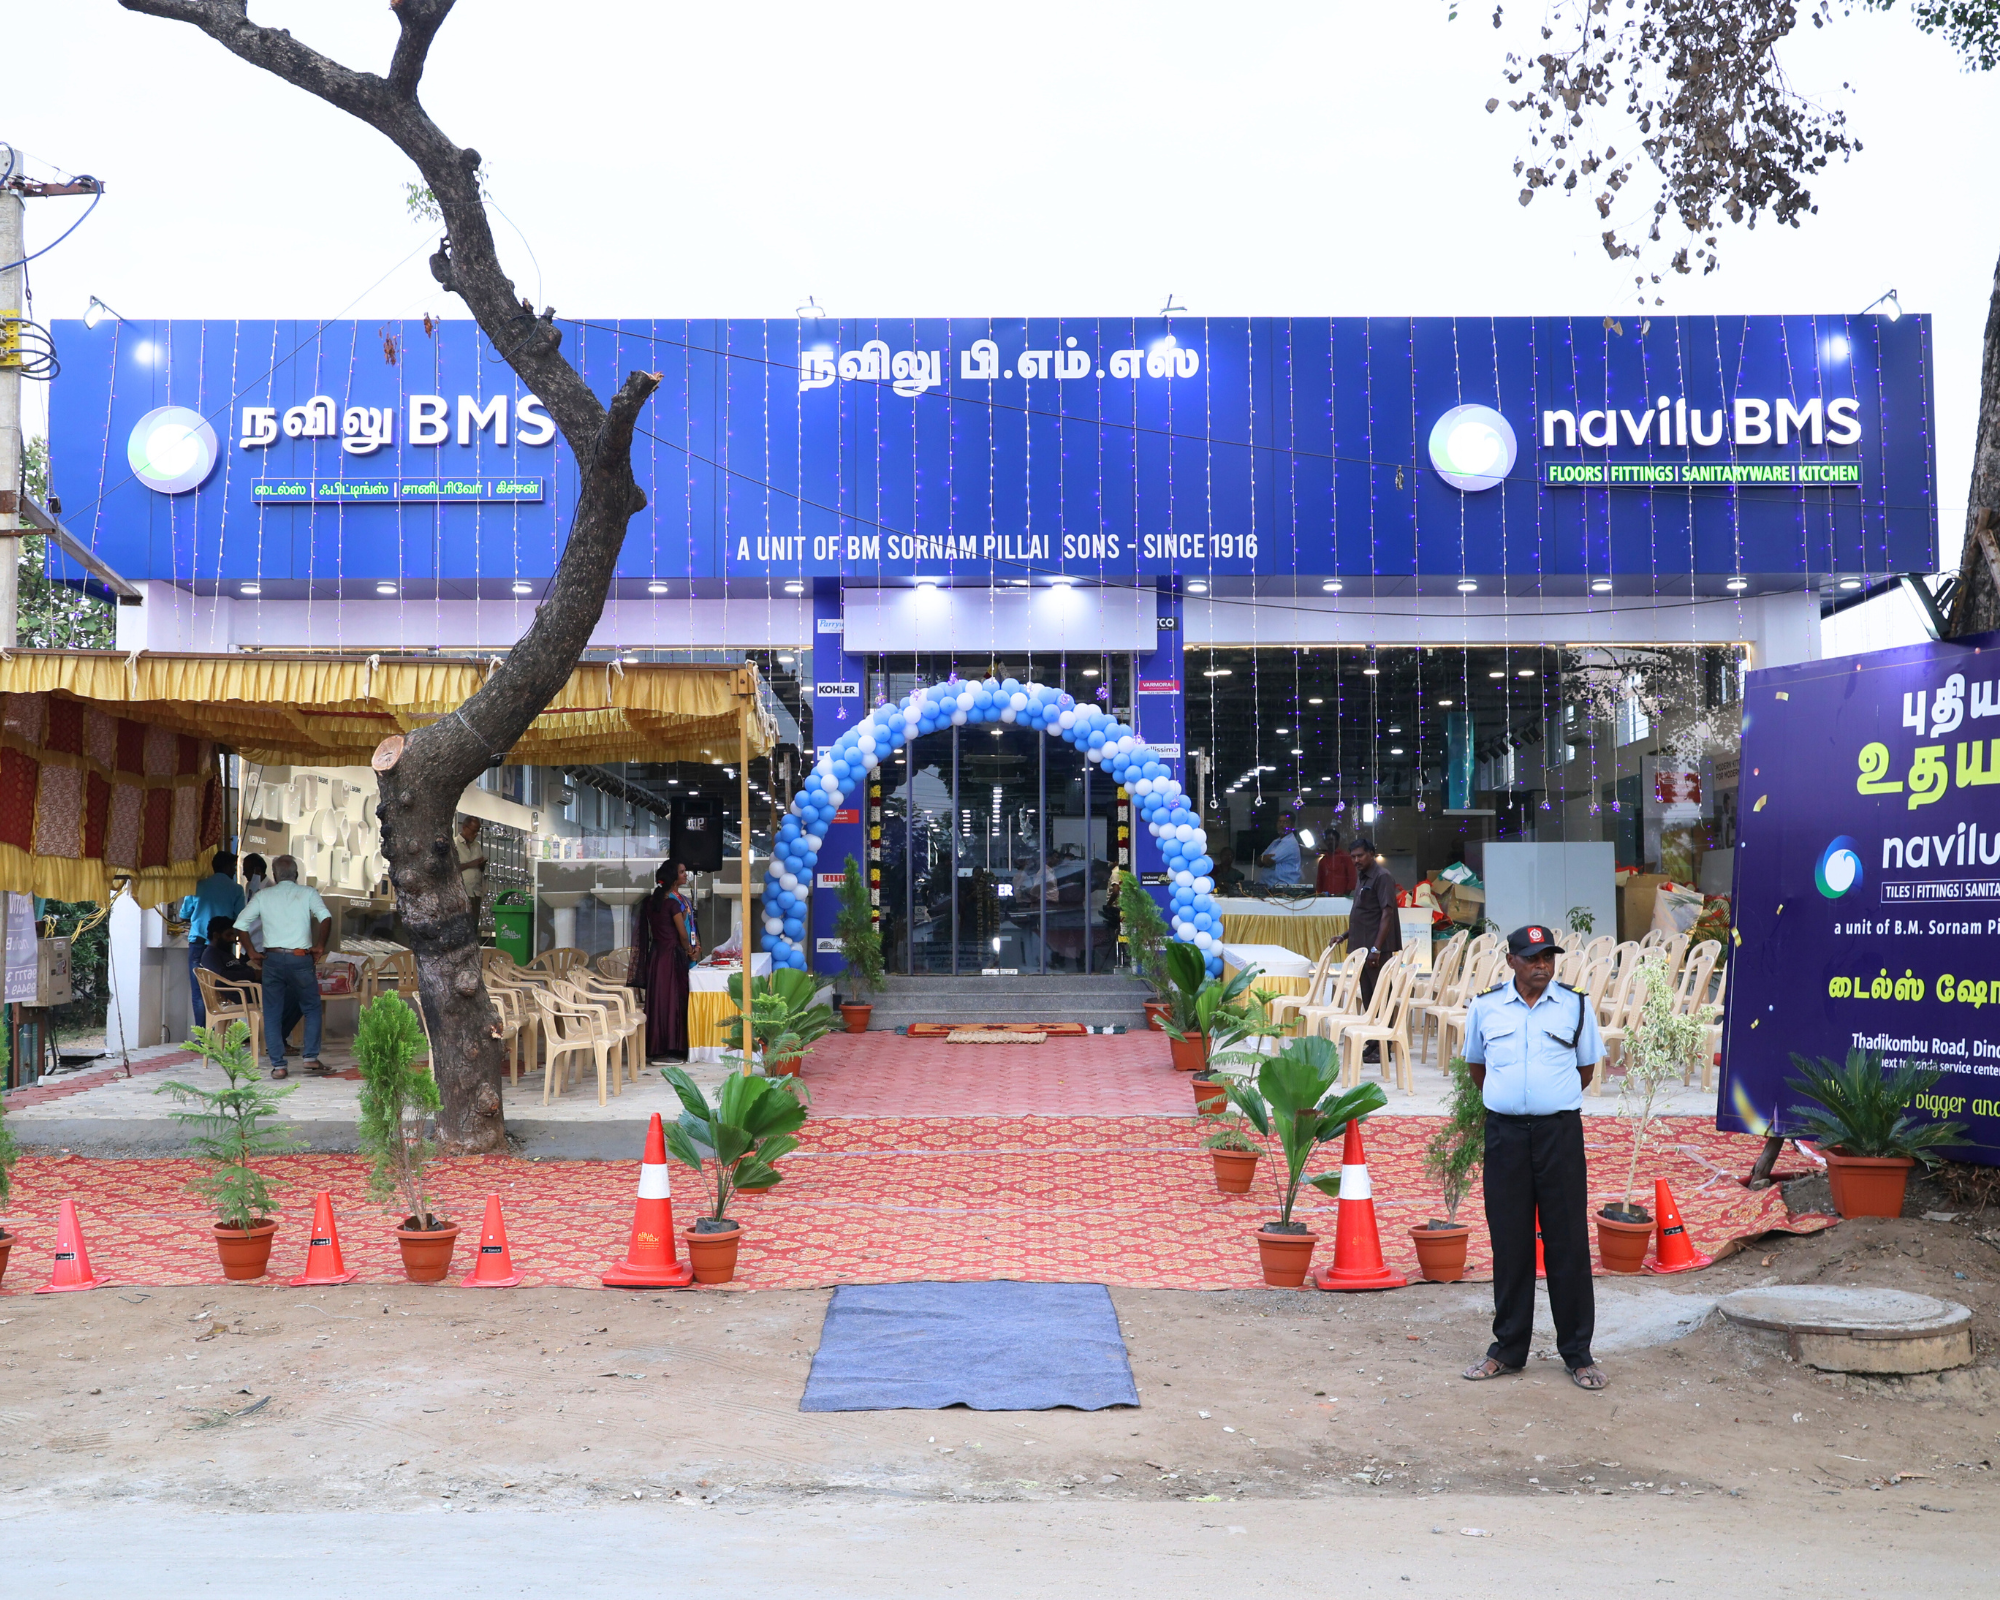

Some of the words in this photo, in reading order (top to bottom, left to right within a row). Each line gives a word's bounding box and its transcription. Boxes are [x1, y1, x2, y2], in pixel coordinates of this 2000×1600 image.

[799, 339, 941, 397] நவிலு
[960, 335, 1199, 380] பி.எம்.எஸ்
[239, 395, 393, 454] நவிலு
[409, 394, 556, 446] BMS
[1549, 465, 1603, 482] FLOORS
[1610, 465, 1674, 482] FITTINGS
[1681, 465, 1790, 482] SANITARYWARE
[1798, 465, 1858, 482] KITCHEN
[737, 536, 750, 561] A
[757, 536, 806, 561] UNIT
[813, 535, 840, 561] OF
[847, 535, 880, 560] BM
[887, 535, 977, 560] SORNAM
[984, 534, 1049, 560] PILLAI
[1063, 533, 1120, 560] SONS
[1143, 533, 1205, 559] SINCE
[1211, 533, 1258, 558] 1916
[818, 685, 855, 694] KOHLER
[1886, 885, 1910, 899] TILES
[1916, 883, 1960, 899] FITTINGS
[1834, 922, 1841, 935] a
[1846, 919, 1872, 935] unit
[1876, 919, 1890, 935] of
[1894, 920, 1924, 935] B.M.
[1928, 920, 1982, 935] Sornam
[1828, 968, 1925, 1002] டைல்ஸ்
[1852, 1032, 1928, 1054] Thadikombu
[1932, 1038, 1969, 1059] Road,
[1940, 1061, 1971, 1074] service
